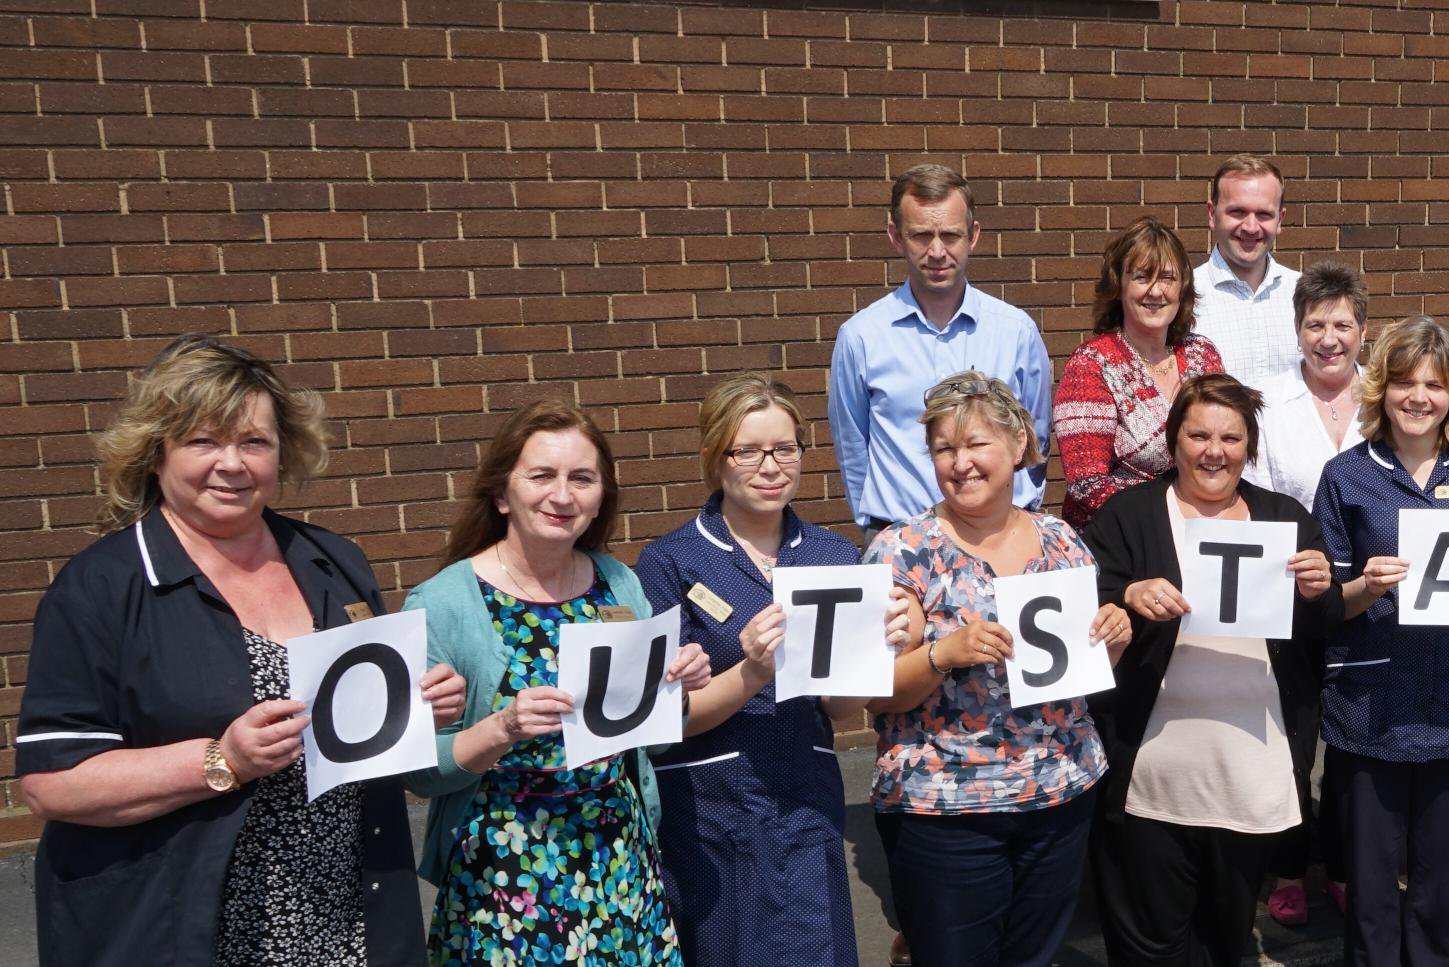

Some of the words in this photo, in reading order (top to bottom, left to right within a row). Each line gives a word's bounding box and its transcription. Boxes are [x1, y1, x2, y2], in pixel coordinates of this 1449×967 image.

[1198, 541, 1263, 624] T
[791, 587, 863, 679] T
[1019, 595, 1069, 688] S
[311, 642, 411, 764] O
[582, 634, 667, 738] U
